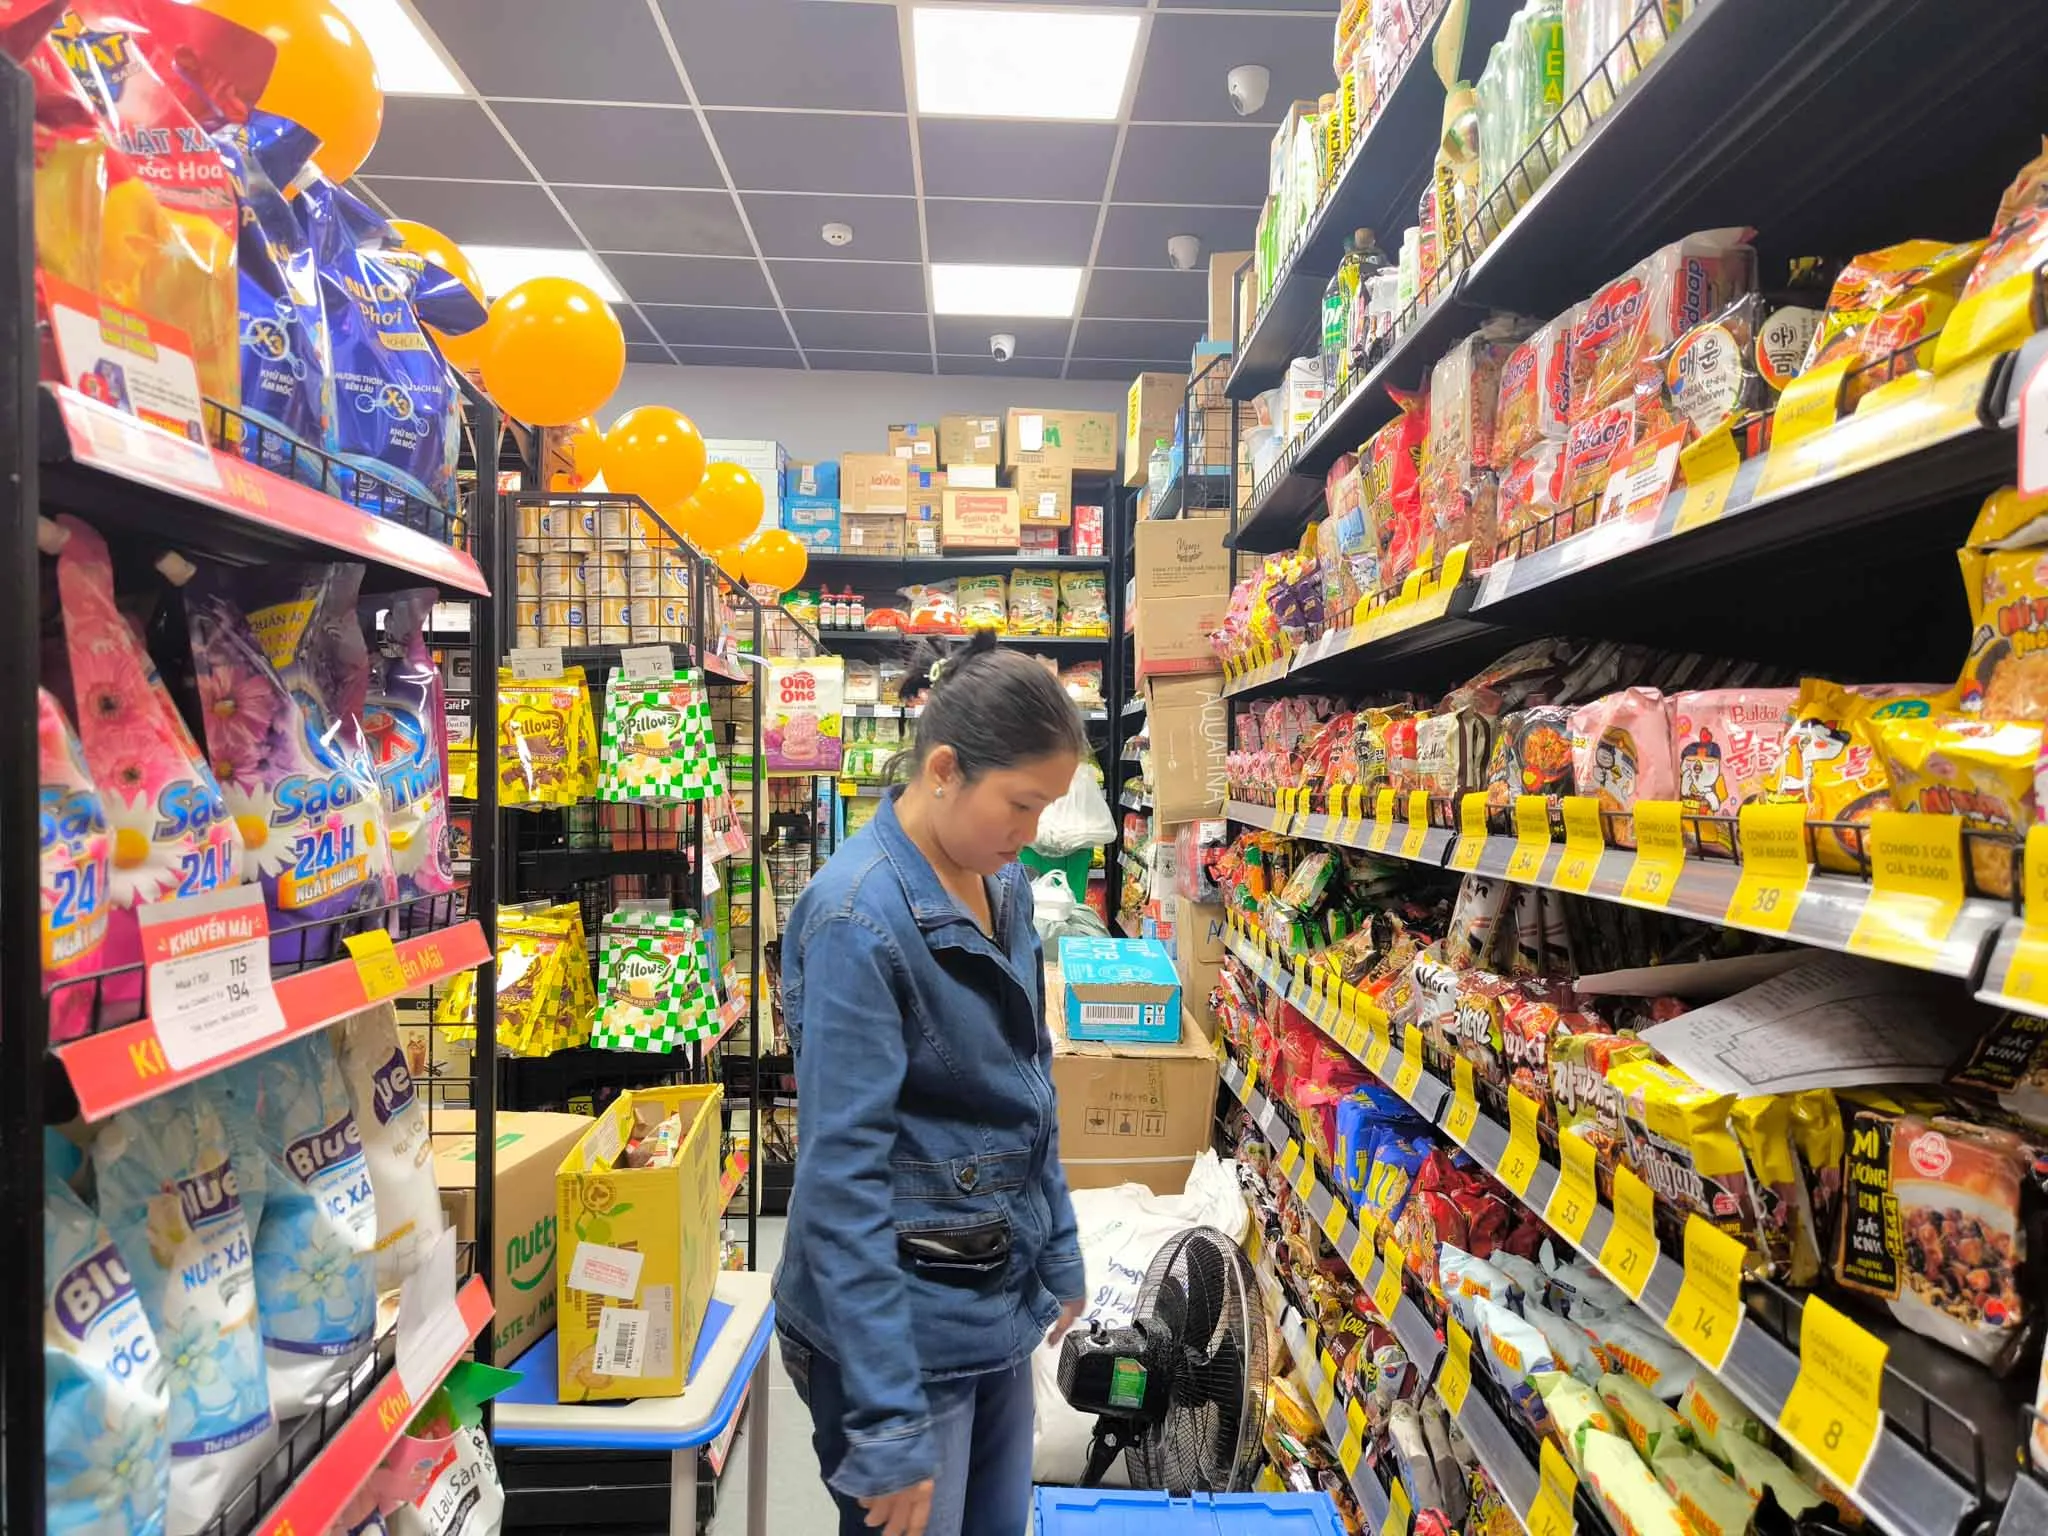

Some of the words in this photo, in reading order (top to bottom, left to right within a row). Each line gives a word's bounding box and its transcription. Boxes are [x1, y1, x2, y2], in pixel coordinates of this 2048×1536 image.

[178, 161, 224, 181] Hoa
[542, 662, 553, 672] 12
[651, 662, 662, 671] 12
[780, 689, 817, 704] One
[626, 715, 675, 736] Pillows
[1197, 687, 1228, 806] AQUAFINA
[1640, 871, 1662, 893] 39
[1750, 888, 1781, 913] 38
[169, 917, 227, 957] KHUYẾN
[230, 955, 248, 977] 115
[618, 962, 665, 981] Pillows
[226, 982, 250, 1003] 194
[291, 1120, 361, 1177] Blue
[1619, 1248, 1638, 1272] 21
[1692, 1306, 1713, 1340] 14
[494, 1319, 524, 1350] ASTE
[1823, 1419, 1844, 1451] 8
